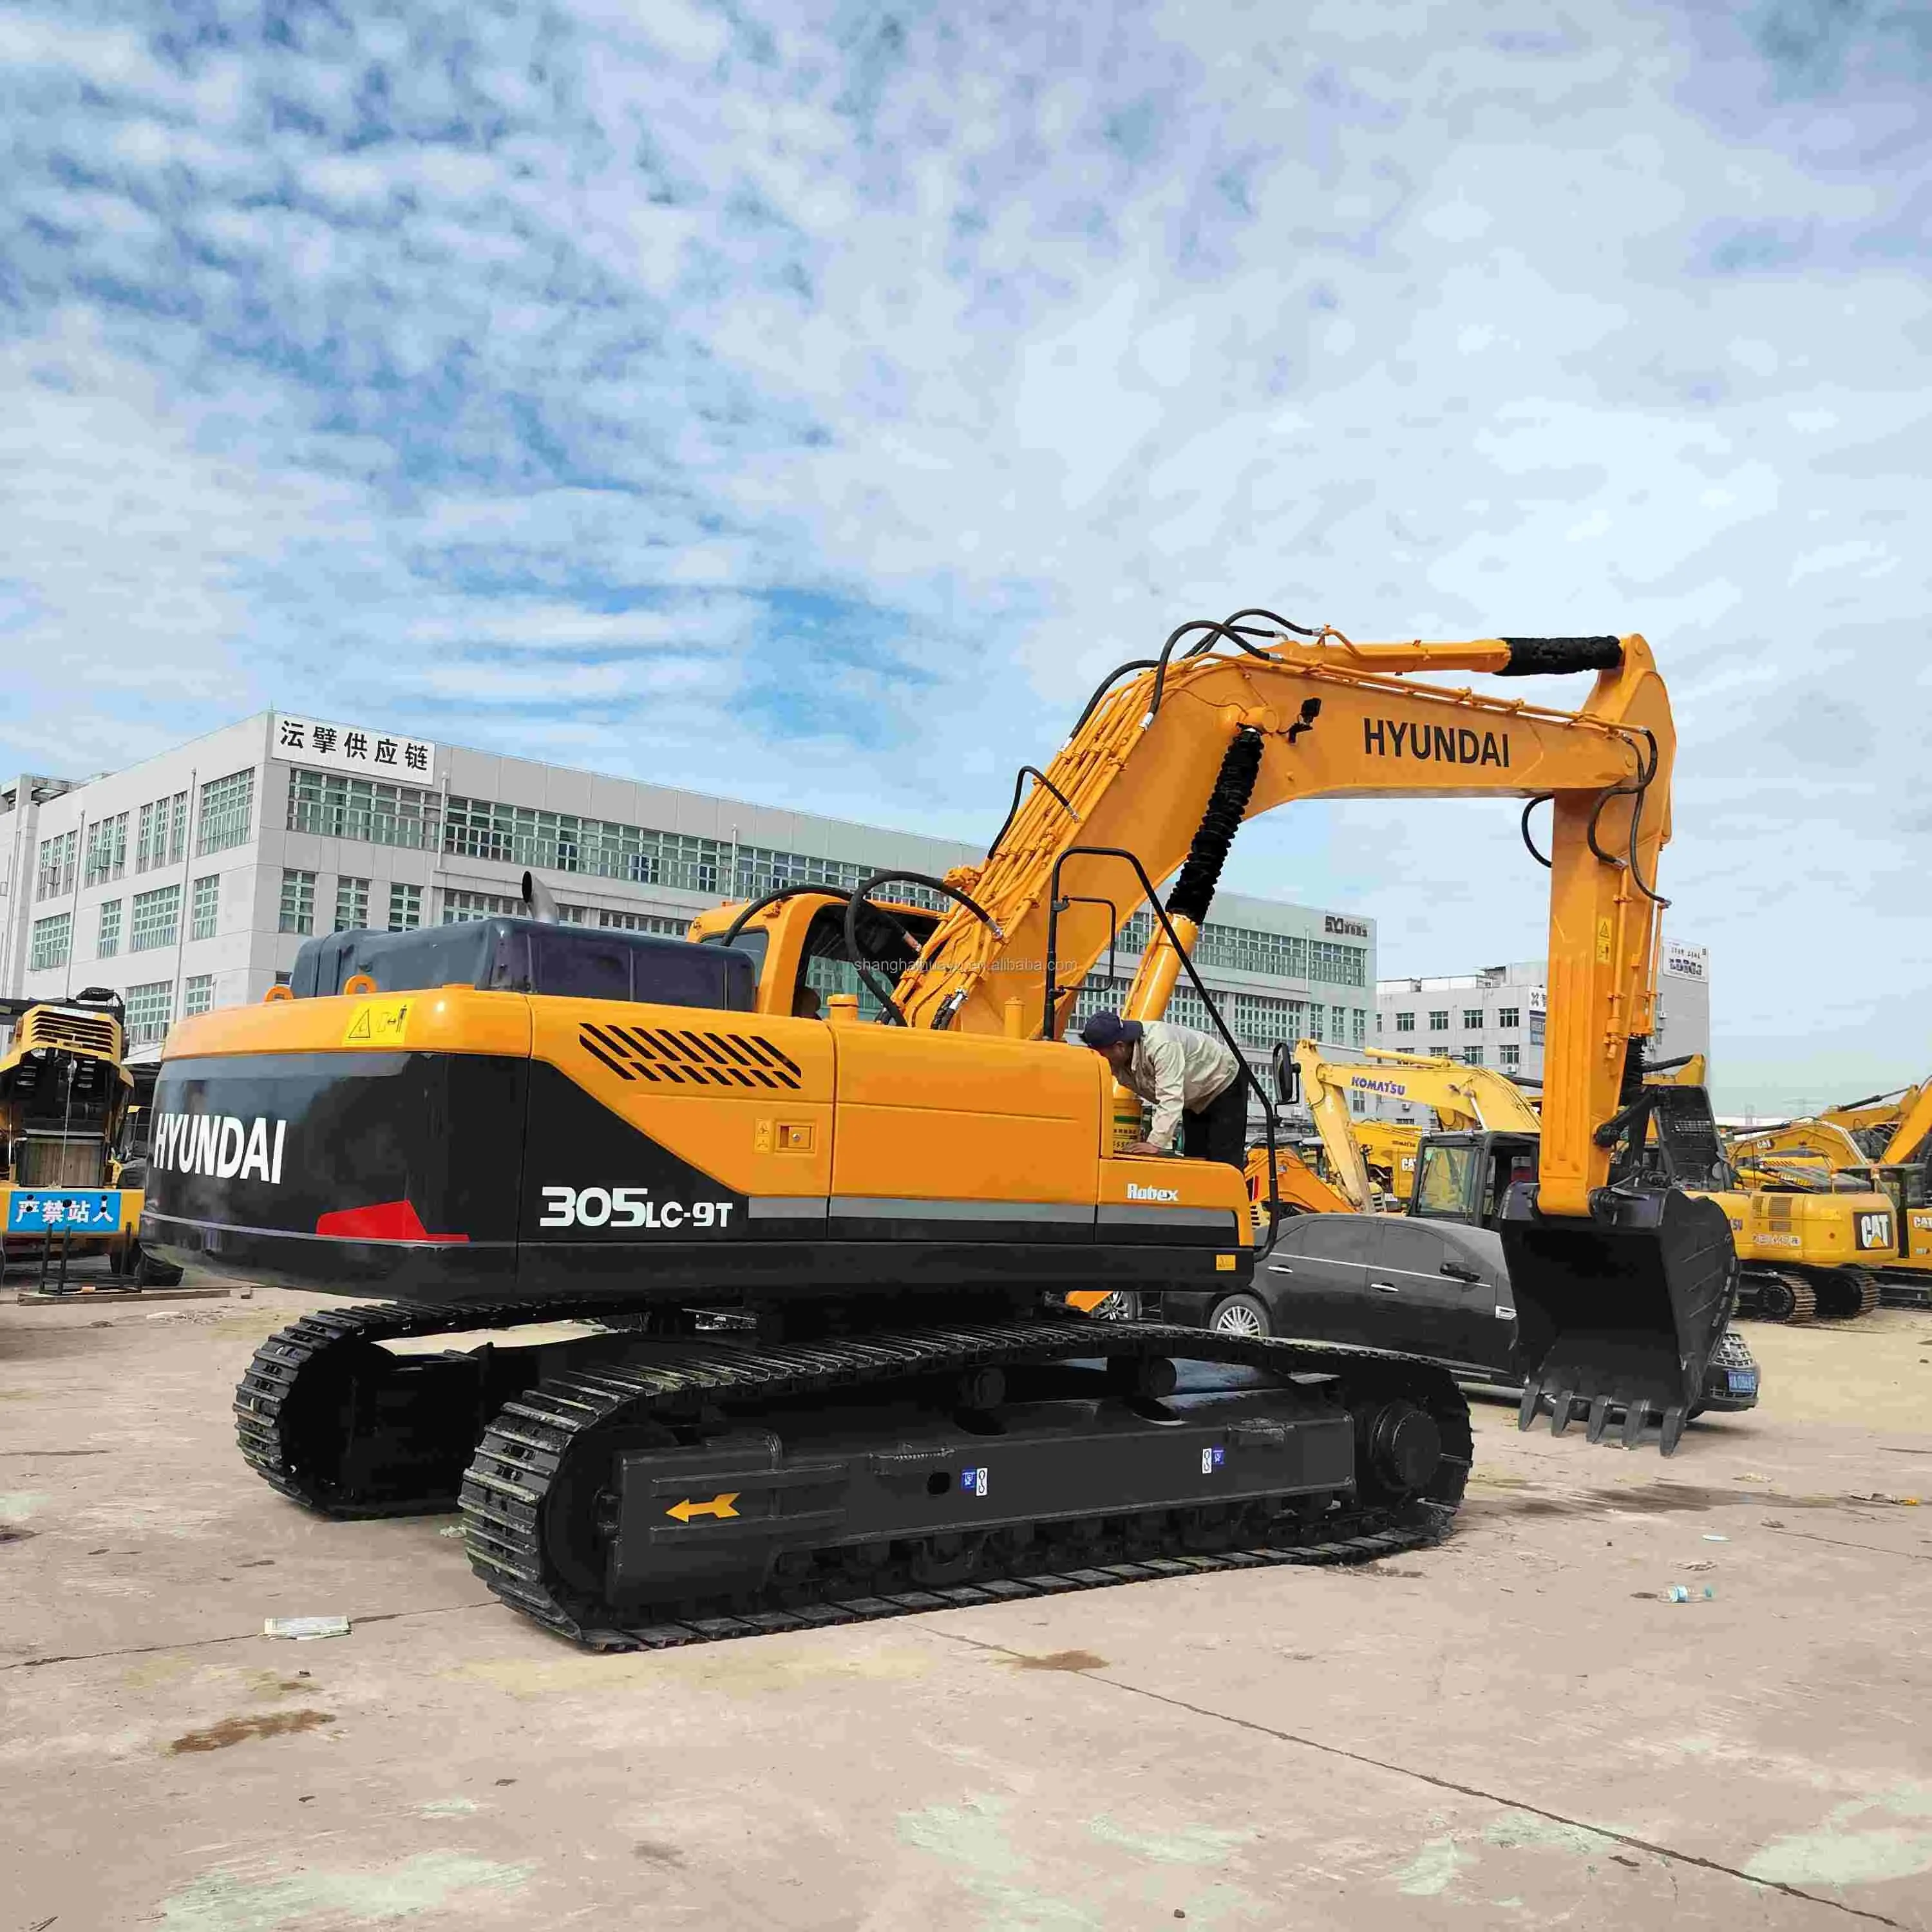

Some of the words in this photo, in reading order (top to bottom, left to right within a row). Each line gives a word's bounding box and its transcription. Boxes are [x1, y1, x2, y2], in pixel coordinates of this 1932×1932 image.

[1364, 717, 1510, 768] HYUNDAI
[1351, 1077, 1405, 1095] KOMATSU
[153, 1113, 287, 1184] HYUNDAI
[540, 1186, 734, 1228] 305LC-9T
[1861, 1215, 1888, 1248] CAT
